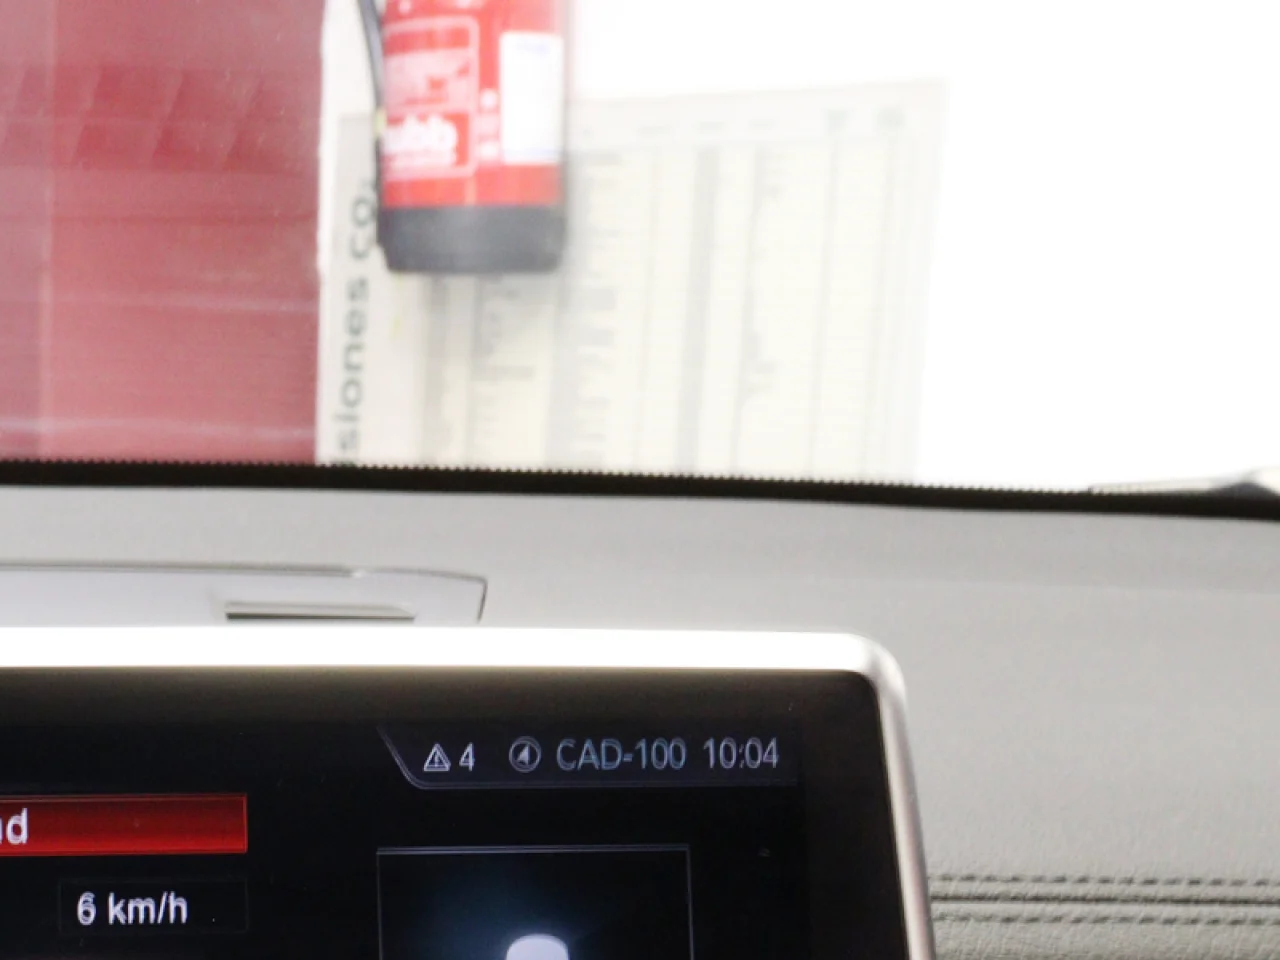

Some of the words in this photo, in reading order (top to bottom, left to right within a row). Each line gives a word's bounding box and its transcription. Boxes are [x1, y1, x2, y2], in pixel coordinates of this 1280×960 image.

[330, 276, 370, 466] siones
[458, 742, 476, 771] 4
[555, 736, 687, 771] CAD-100
[703, 736, 780, 769] 10:04
[76, 891, 97, 926] 6
[107, 890, 188, 925] km/h
